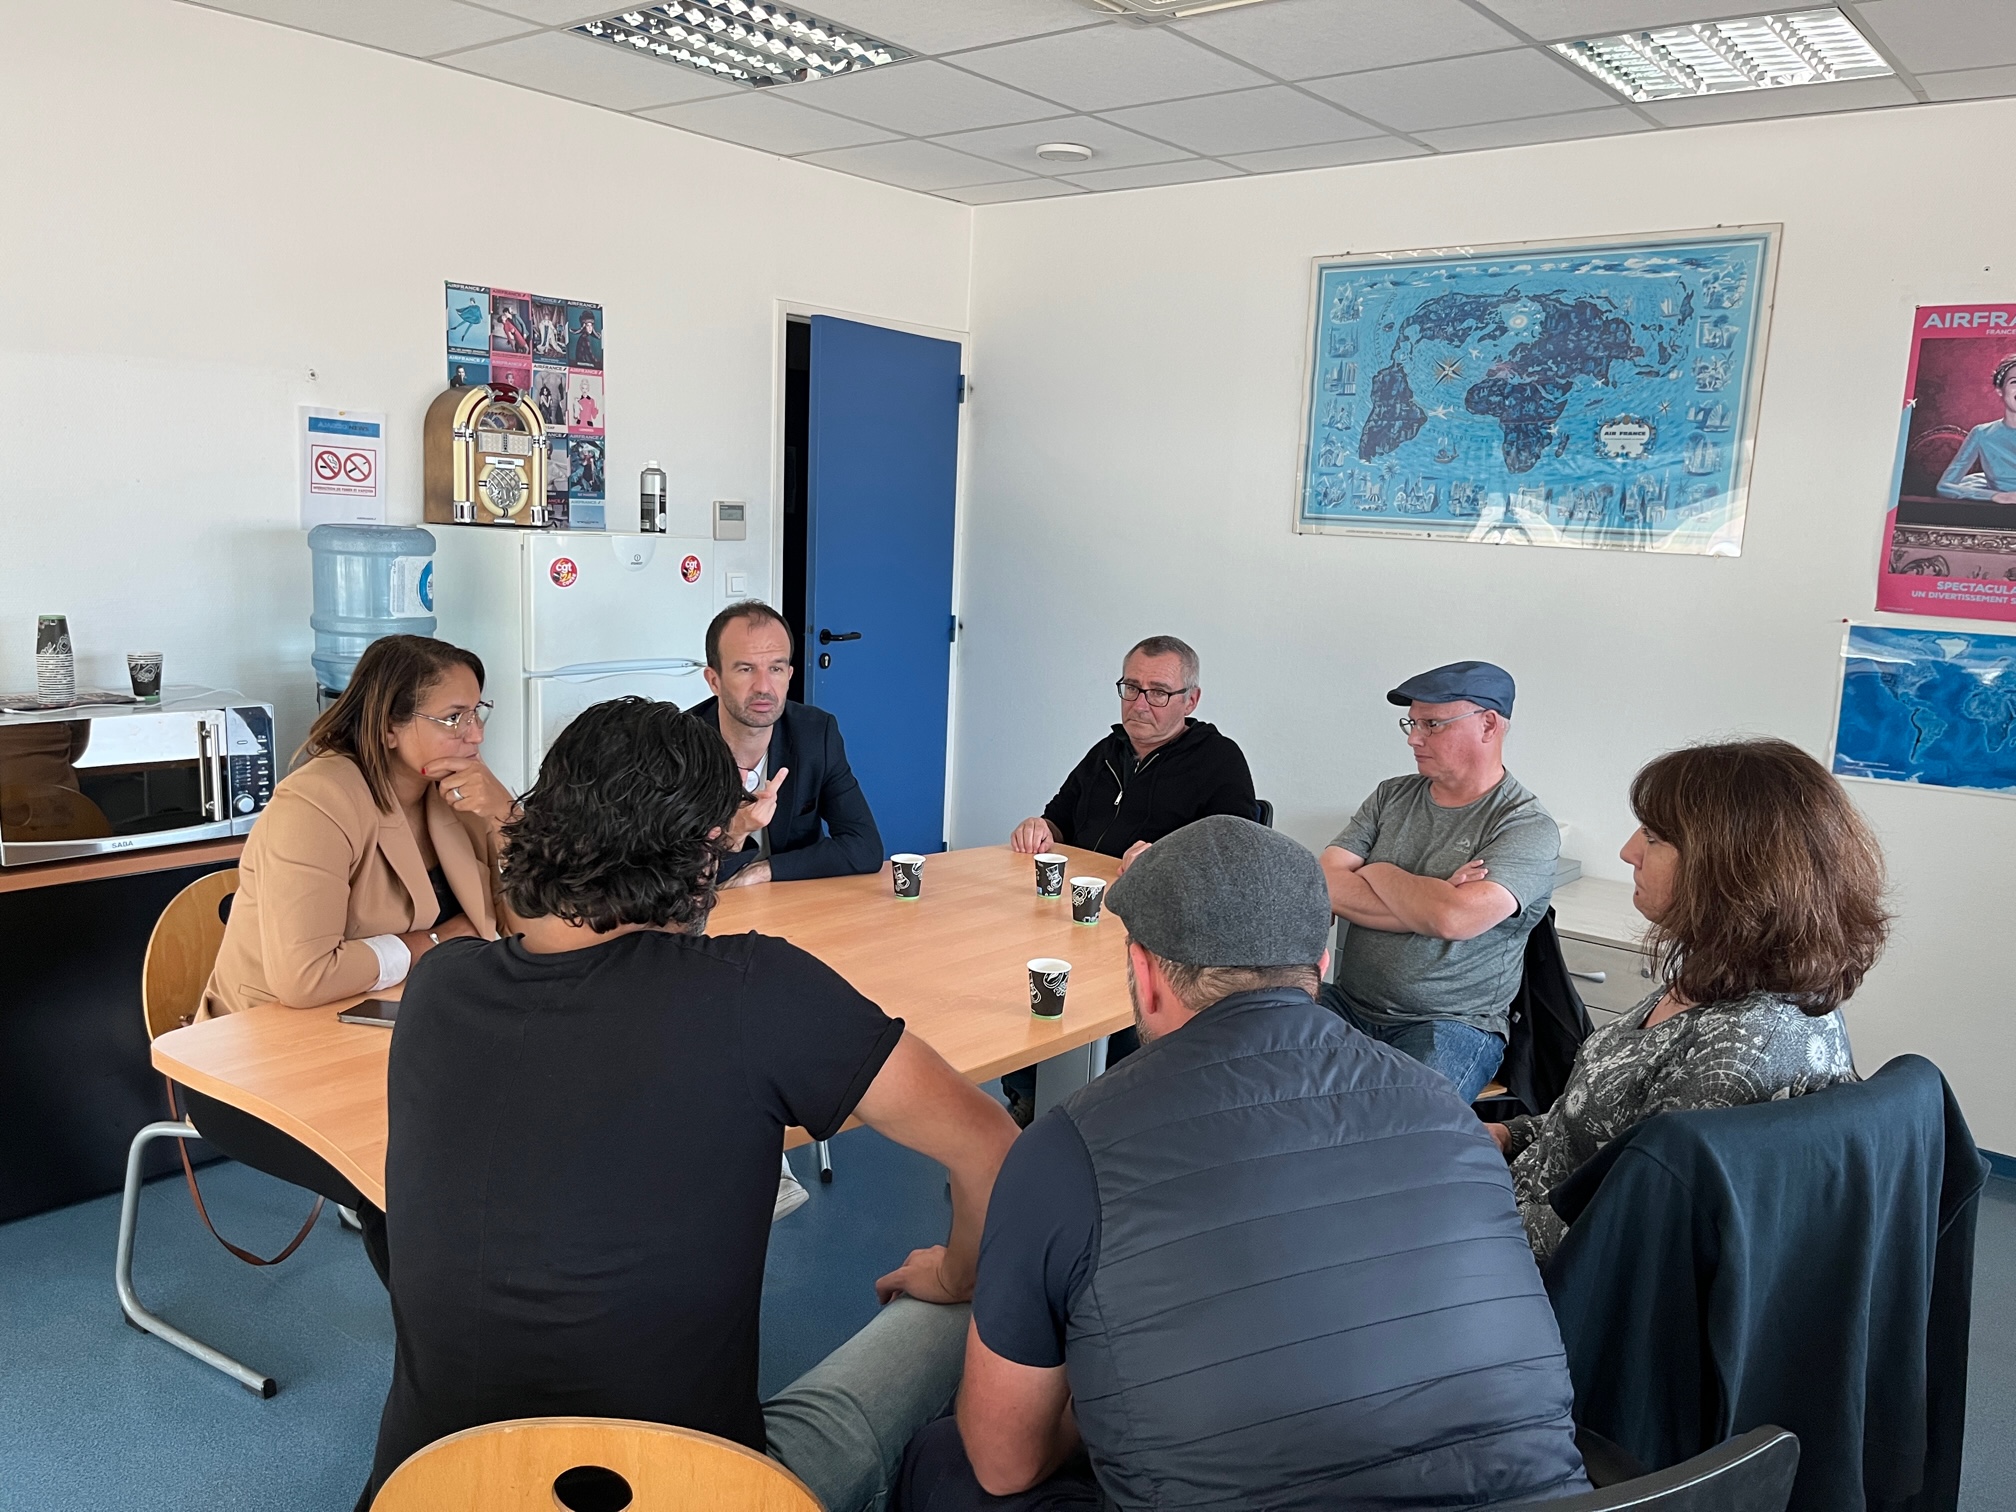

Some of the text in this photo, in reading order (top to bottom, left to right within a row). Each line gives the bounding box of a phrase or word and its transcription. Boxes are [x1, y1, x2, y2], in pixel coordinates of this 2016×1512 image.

[446, 284, 480, 292] AIRFRANCE
[567, 301, 596, 309] AIRFRANCE
[448, 354, 481, 363] AIRFRANCE
[556, 562, 572, 573] cgt
[686, 560, 698, 570] cgt
[1936, 581, 2016, 595] SPECTACULA
[1911, 590, 1926, 598] UN
[1928, 591, 2008, 604] DIVERTISSEMENT
